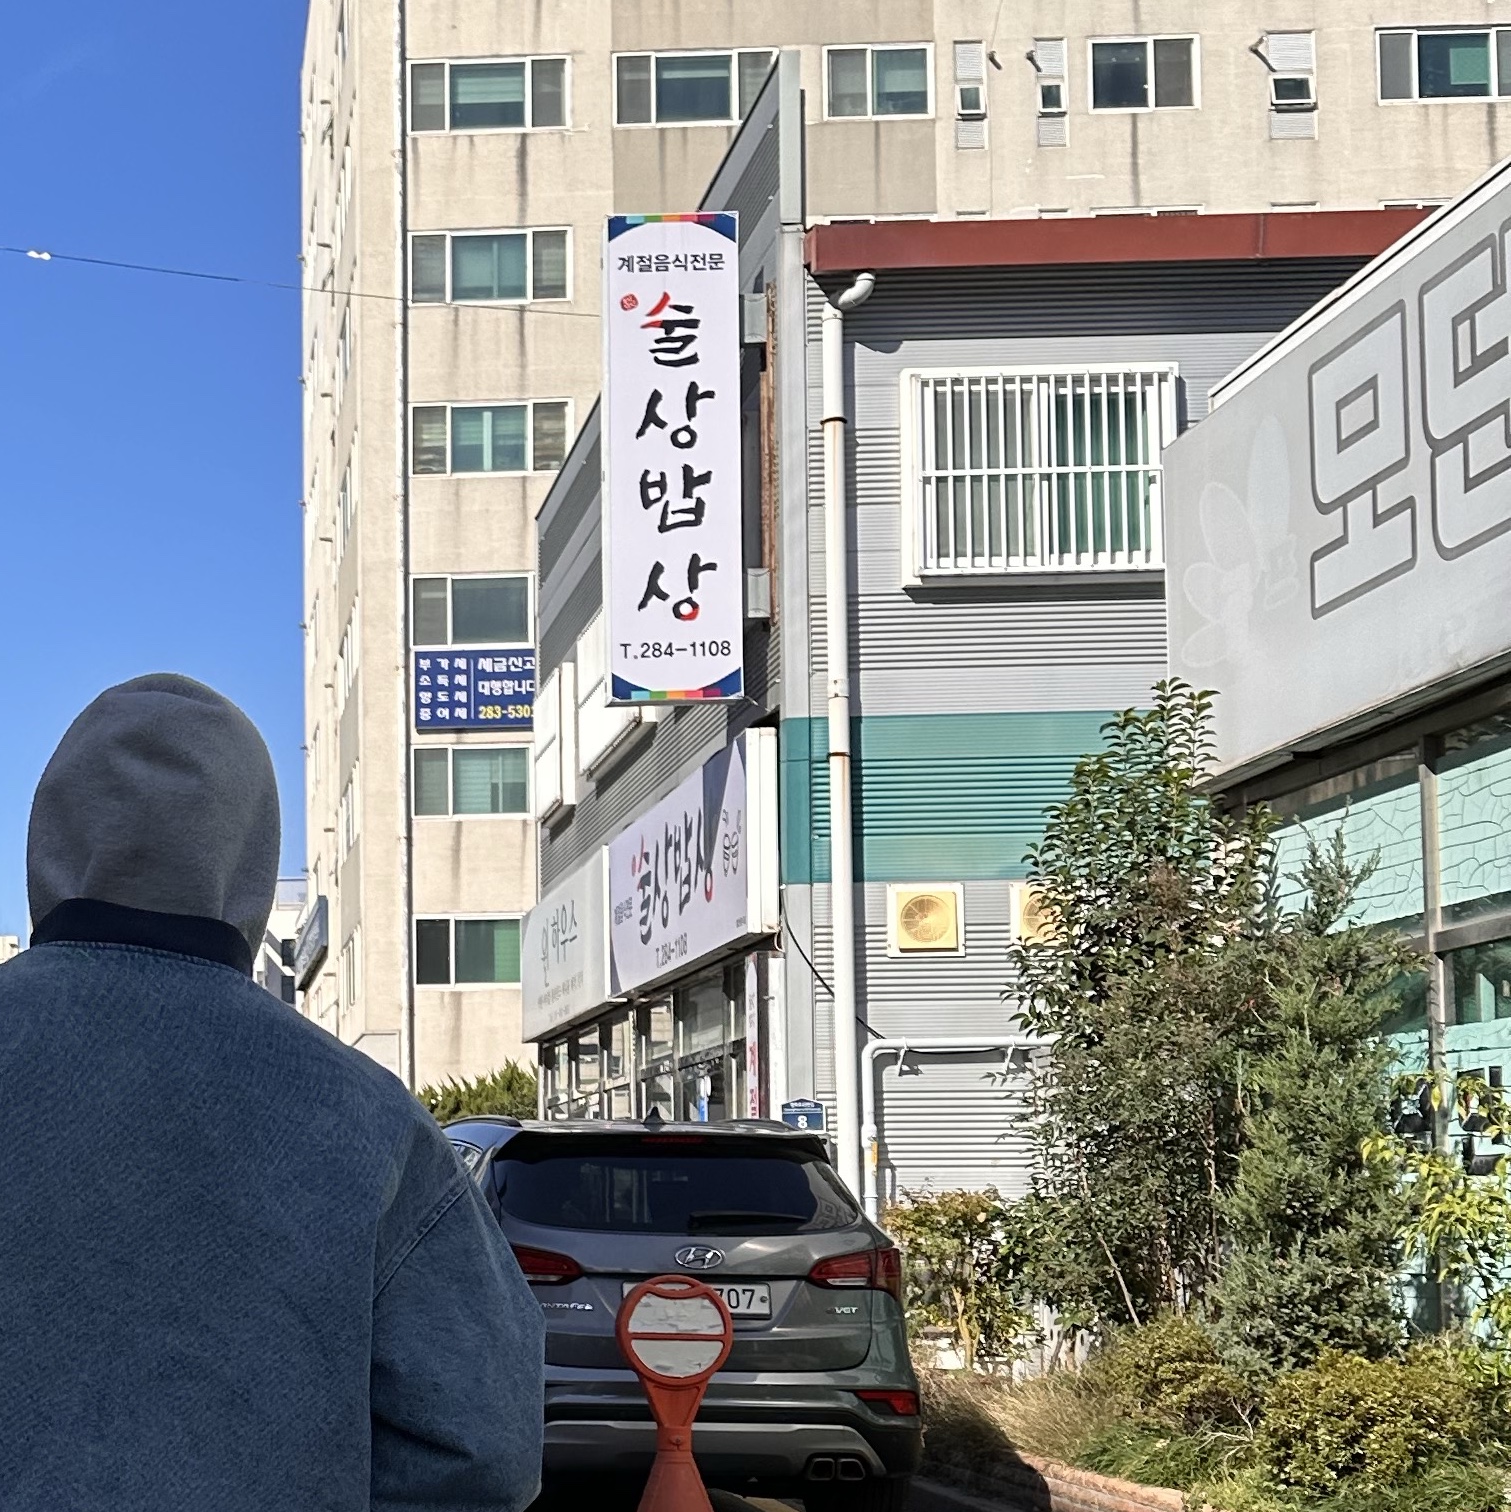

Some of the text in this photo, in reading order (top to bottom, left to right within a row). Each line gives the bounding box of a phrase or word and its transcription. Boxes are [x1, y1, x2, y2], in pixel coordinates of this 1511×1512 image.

[617, 252, 726, 273] 계절음식전문
[619, 640, 732, 660] T.284-1108
[477, 656, 535, 673] 세금신고
[797, 1115, 808, 1129] 8
